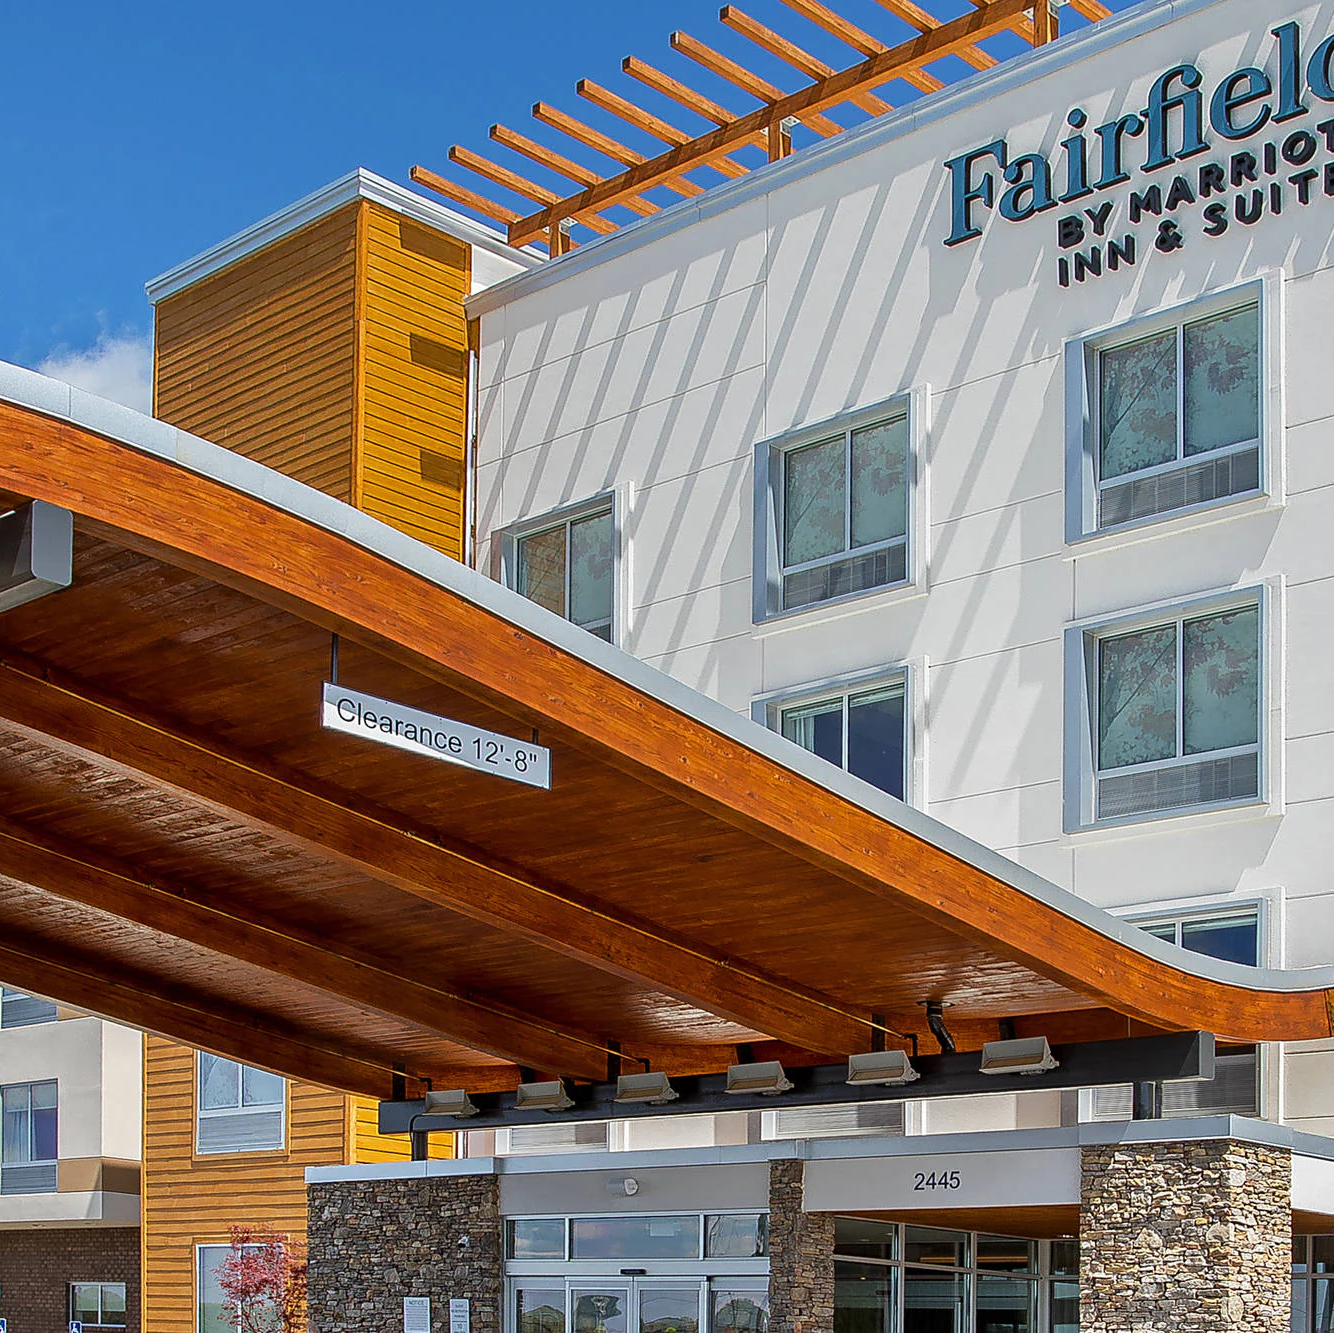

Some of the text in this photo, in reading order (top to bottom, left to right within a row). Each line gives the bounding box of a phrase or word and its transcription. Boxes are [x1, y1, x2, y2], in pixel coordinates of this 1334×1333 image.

[1057, 202, 1113, 249] BY
[1058, 234, 1136, 287] INN
[1154, 220, 1184, 253] &
[336, 698, 538, 773] Clearance 12'-8"
[913, 1171, 961, 1191] 2445
